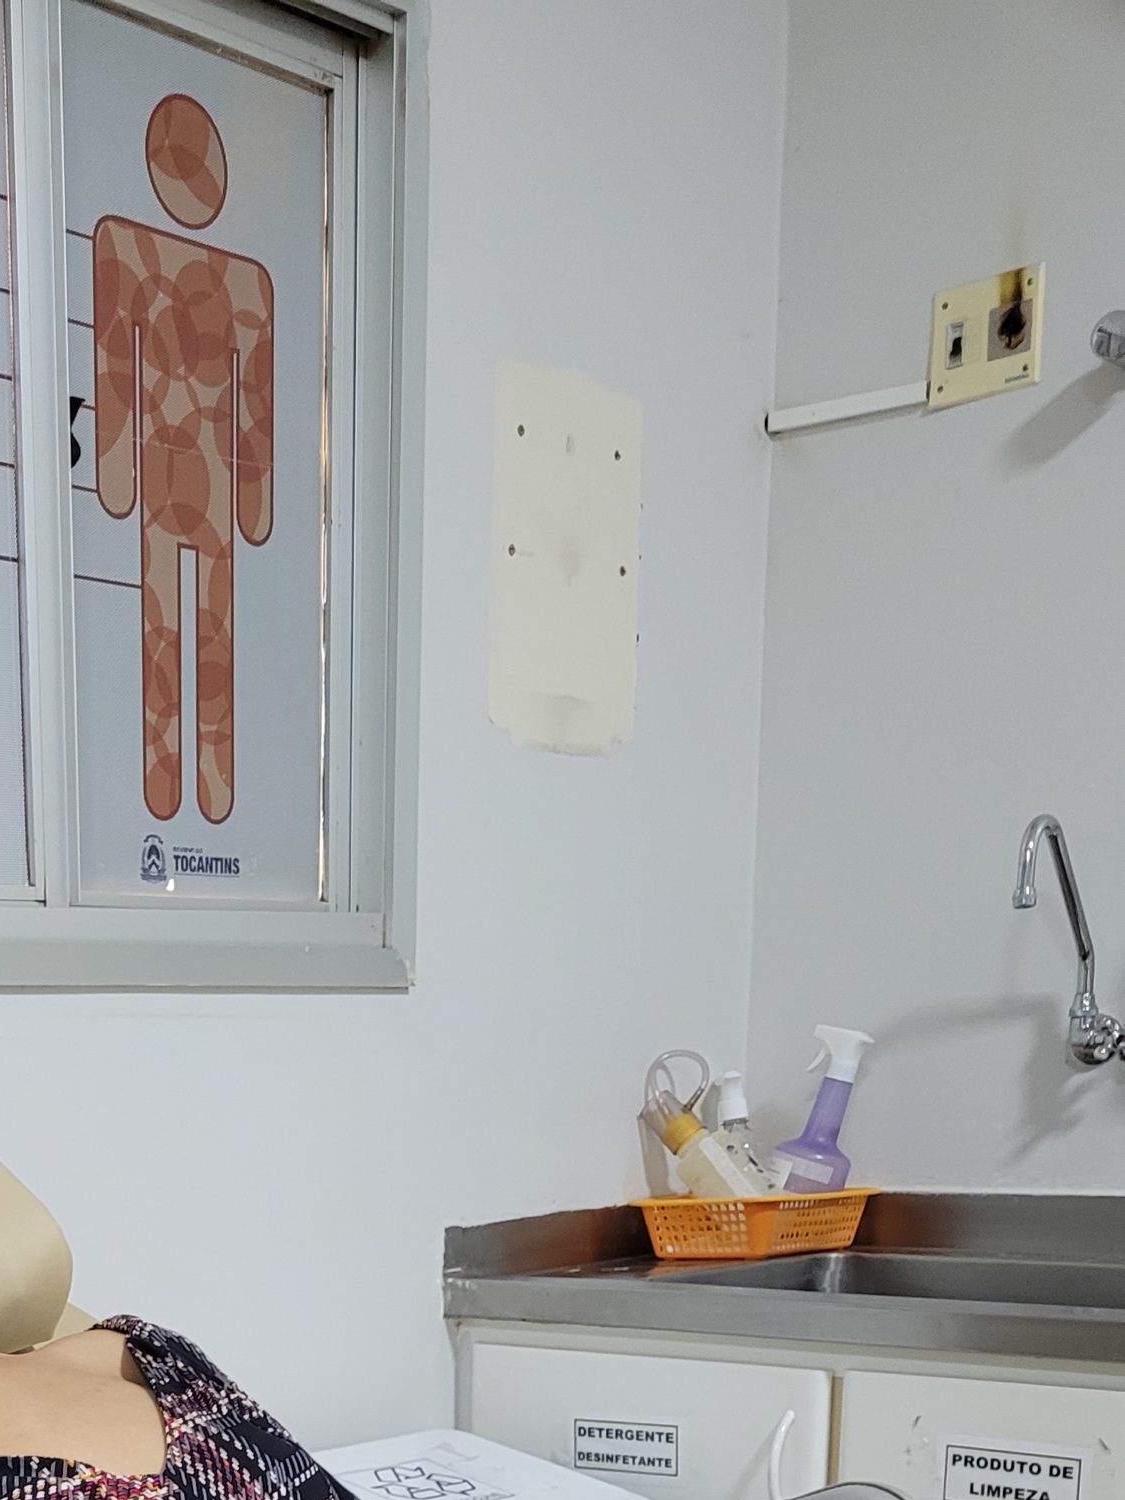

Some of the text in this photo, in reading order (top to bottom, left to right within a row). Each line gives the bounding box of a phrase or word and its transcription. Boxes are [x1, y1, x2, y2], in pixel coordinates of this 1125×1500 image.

[173, 854, 240, 875] TOCANTINS
[577, 1426, 675, 1444] DETERGENTE
[577, 1451, 673, 1468] DESINFETANTE
[952, 1453, 1074, 1480] PRODUTO DE
